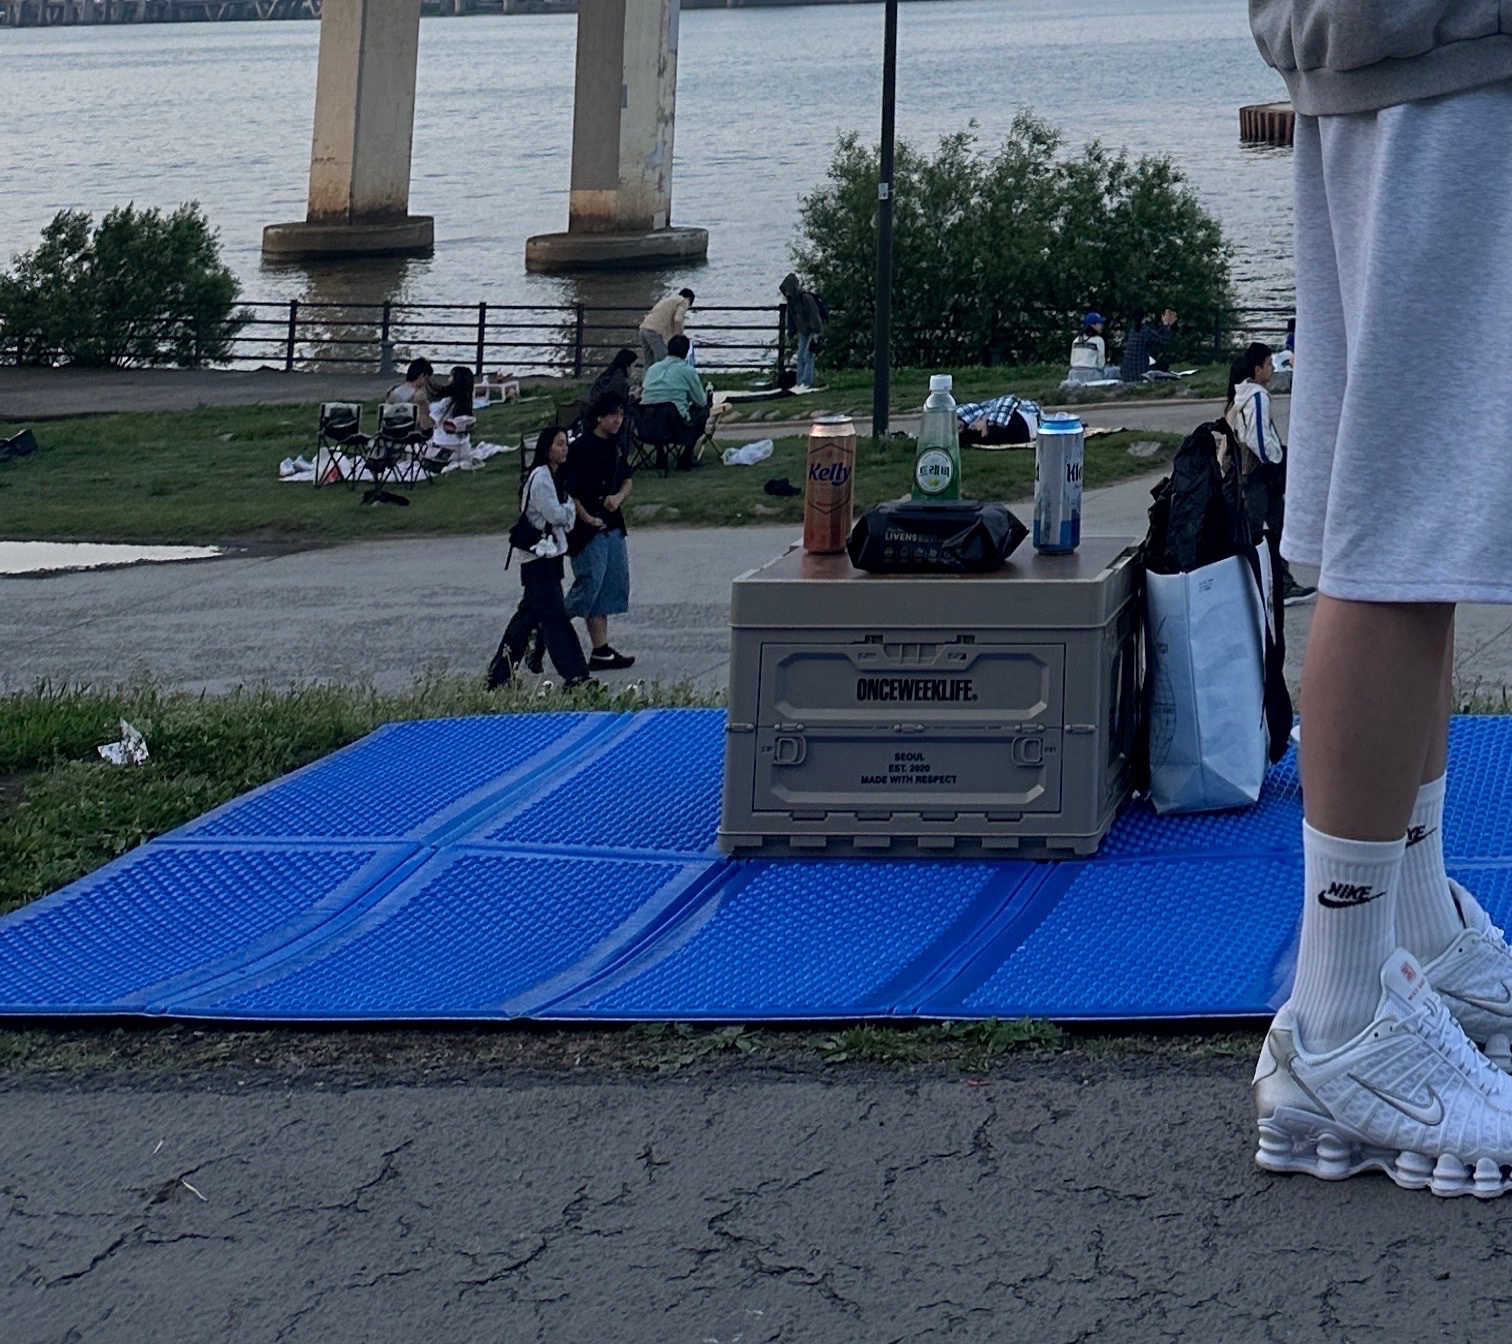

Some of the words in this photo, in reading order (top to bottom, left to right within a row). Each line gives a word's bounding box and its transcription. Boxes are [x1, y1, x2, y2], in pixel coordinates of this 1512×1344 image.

[809, 463, 852, 486] Kelly
[919, 464, 950, 478] 트레비
[894, 752, 925, 762] SEOUL
[888, 763, 907, 773] EST.
[909, 763, 931, 773] 2020
[860, 775, 888, 784] MADE
[889, 775, 913, 784] WITH
[915, 774, 958, 784] RESPECT
[1327, 882, 1373, 900] NIKE
